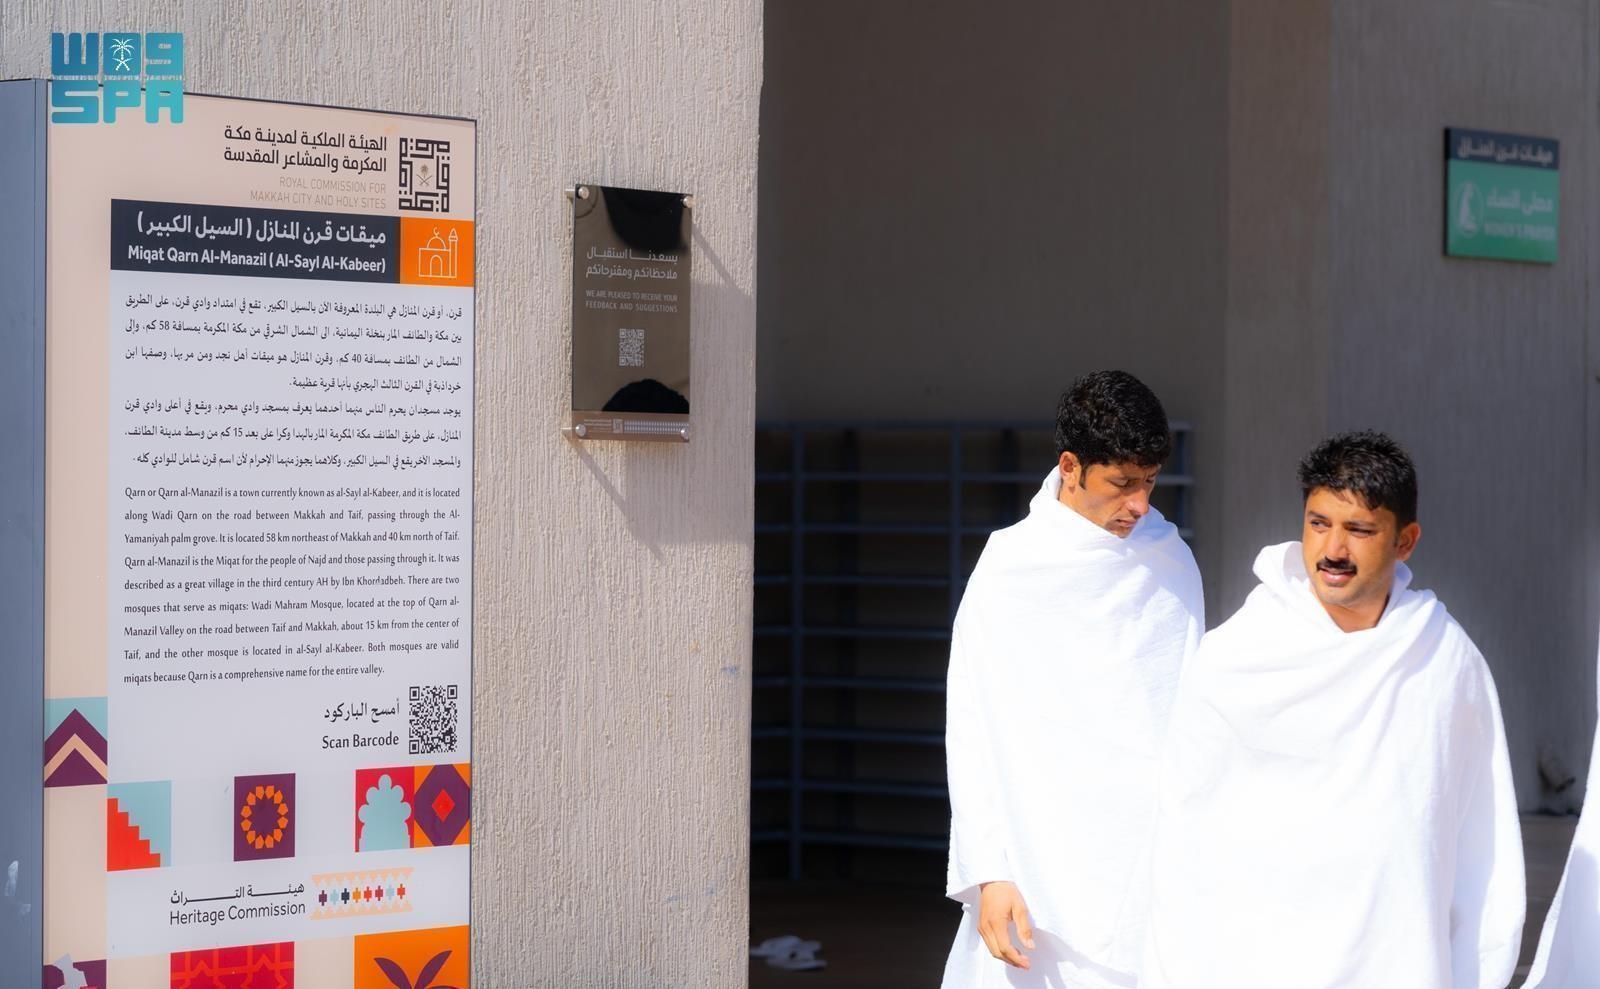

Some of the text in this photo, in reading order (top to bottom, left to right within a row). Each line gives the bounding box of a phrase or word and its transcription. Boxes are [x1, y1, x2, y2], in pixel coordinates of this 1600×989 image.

[224, 125, 387, 151] الهيئة الملكية لمدينة مكة
[224, 146, 387, 174] المكرمة والمشاعر المقدسة
[280, 176, 387, 194] ROYAL COMMISSION FOR
[250, 190, 386, 210] MAKKAH CITY AND HOLY SITES
[146, 215, 191, 237] الكبير
[256, 220, 299, 242] المنازل
[303, 221, 332, 245] قرن
[336, 225, 386, 248] ميقات
[128, 245, 165, 264] Miqat
[167, 247, 198, 263] Qarn
[201, 249, 266, 266] Al-Manazil
[322, 256, 386, 273] Al-Kabeer)
[586, 300, 678, 313] FEEDBACK AND SUGGESTIONS
[125, 487, 146, 500] Qarn
[158, 487, 179, 500] Qarn
[180, 487, 223, 497] al-Manazil
[225, 488, 232, 497] is
[261, 487, 297, 501] currently
[298, 487, 325, 497] known
[336, 487, 362, 501] al-Sayl
[363, 487, 401, 498] al-Kabeer,
[402, 488, 416, 497] and
[418, 488, 424, 497] it
[425, 488, 432, 497] is
[433, 488, 460, 497] located
[124, 510, 148, 524] along
[152, 510, 173, 520] Wadi
[177, 510, 198, 523] Qarn
[216, 509, 230, 520] the
[234, 509, 252, 520] road
[256, 510, 290, 520] between
[294, 509, 326, 520] Makkah
[330, 509, 344, 520] and
[348, 509, 364, 520] Taif,
[368, 510, 396, 523] passing
[400, 509, 430, 523] through
[434, 509, 446, 519] the
[449, 509, 460, 519] Al-
[124, 605, 161, 616] mosques
[164, 602, 180, 612] that
[184, 604, 205, 612] serve
[220, 602, 249, 614] miqats:
[251, 600, 272, 610] Wadi
[275, 599, 308, 610] Mahram
[310, 600, 344, 612] Mosque,
[346, 598, 374, 608] located
[377, 600, 385, 608] at
[388, 597, 400, 607] the
[403, 600, 416, 610] top
[418, 596, 426, 607] of
[428, 597, 448, 609] Qarn
[450, 596, 460, 606] al-
[124, 649, 141, 660] Taif,
[145, 648, 160, 659] and
[164, 648, 178, 659] the
[182, 647, 204, 658] other
[207, 649, 239, 660] mosque
[242, 647, 249, 656] is
[252, 644, 282, 656] located
[285, 645, 293, 655] in
[296, 643, 322, 657] al-Sayl
[326, 642, 364, 653] al-Kabeer.
[368, 642, 386, 652] Both
[390, 643, 423, 654] mosques
[441, 639, 459, 650] valid
[124, 664, 385, 686] miqats because Qarn is a comprehensive name for the entire valley.
[324, 698, 400, 723] أمسح الباركود
[322, 731, 399, 749] Scan Barcode
[170, 901, 306, 926] Heritage Commission
